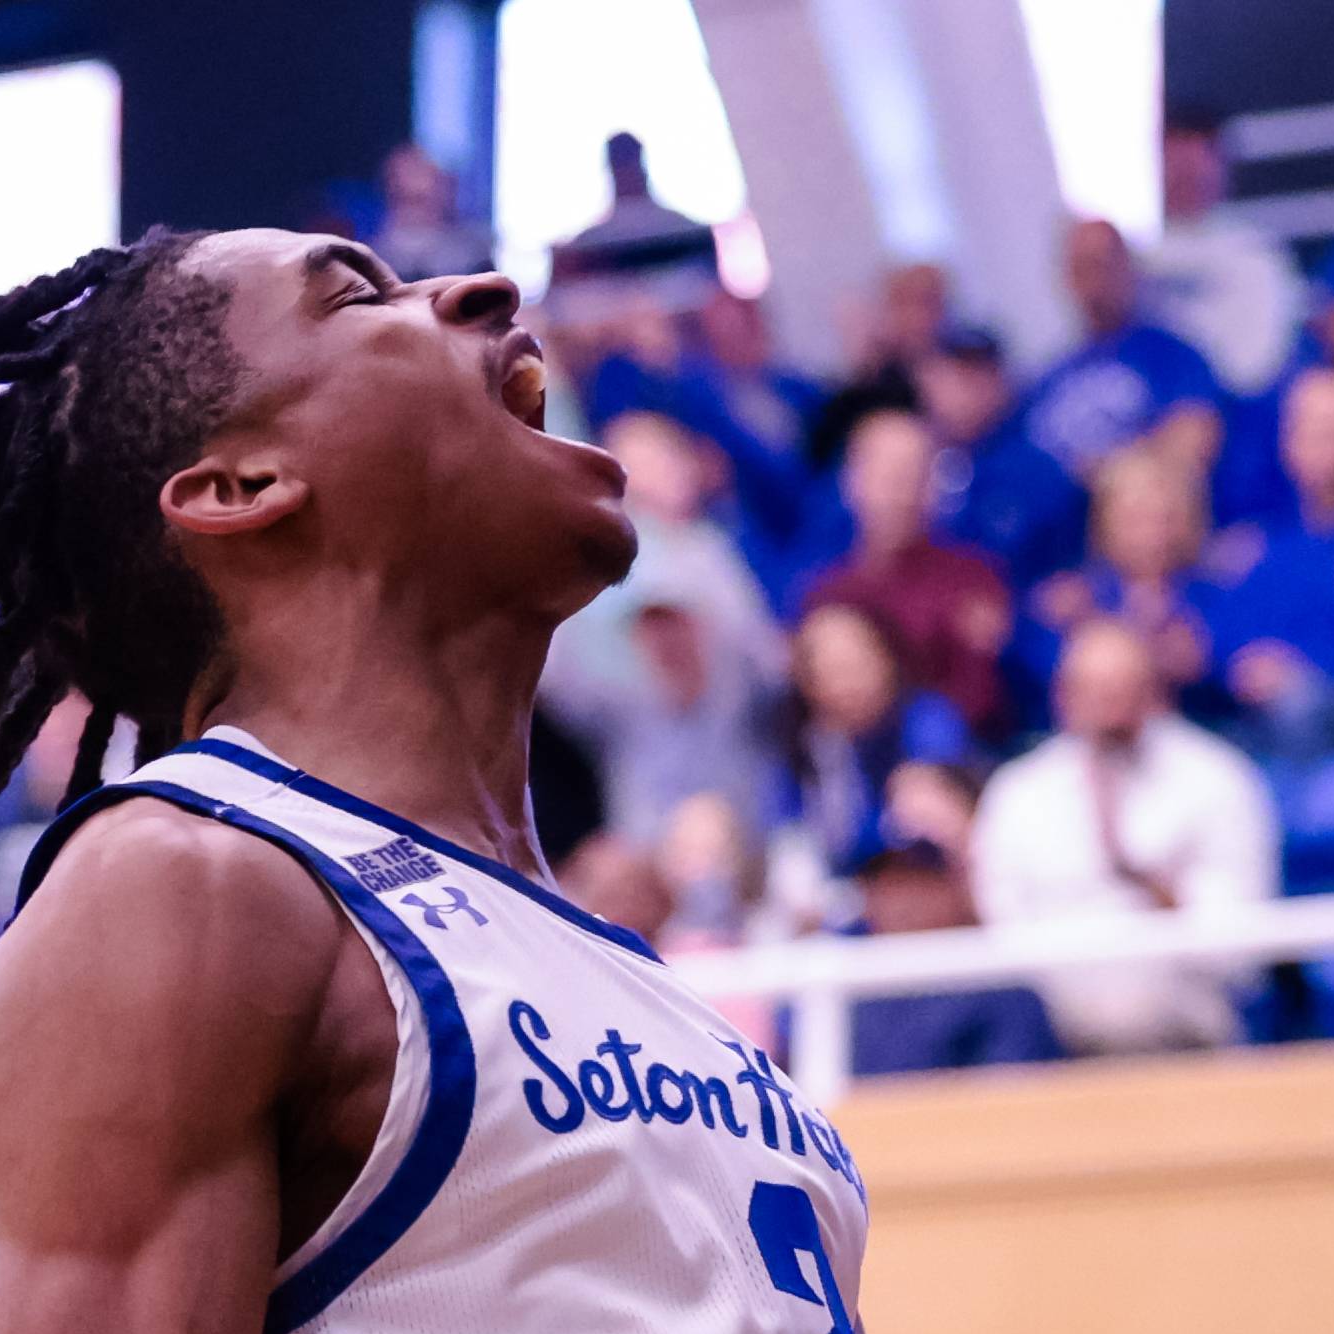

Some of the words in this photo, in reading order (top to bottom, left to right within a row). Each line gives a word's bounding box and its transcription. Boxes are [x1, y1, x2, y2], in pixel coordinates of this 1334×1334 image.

[345, 852, 380, 873] BE
[371, 836, 420, 866] THE
[359, 853, 445, 892] CHANGE
[507, 999, 749, 1138] Seton
[707, 1031, 867, 1206] Ha
